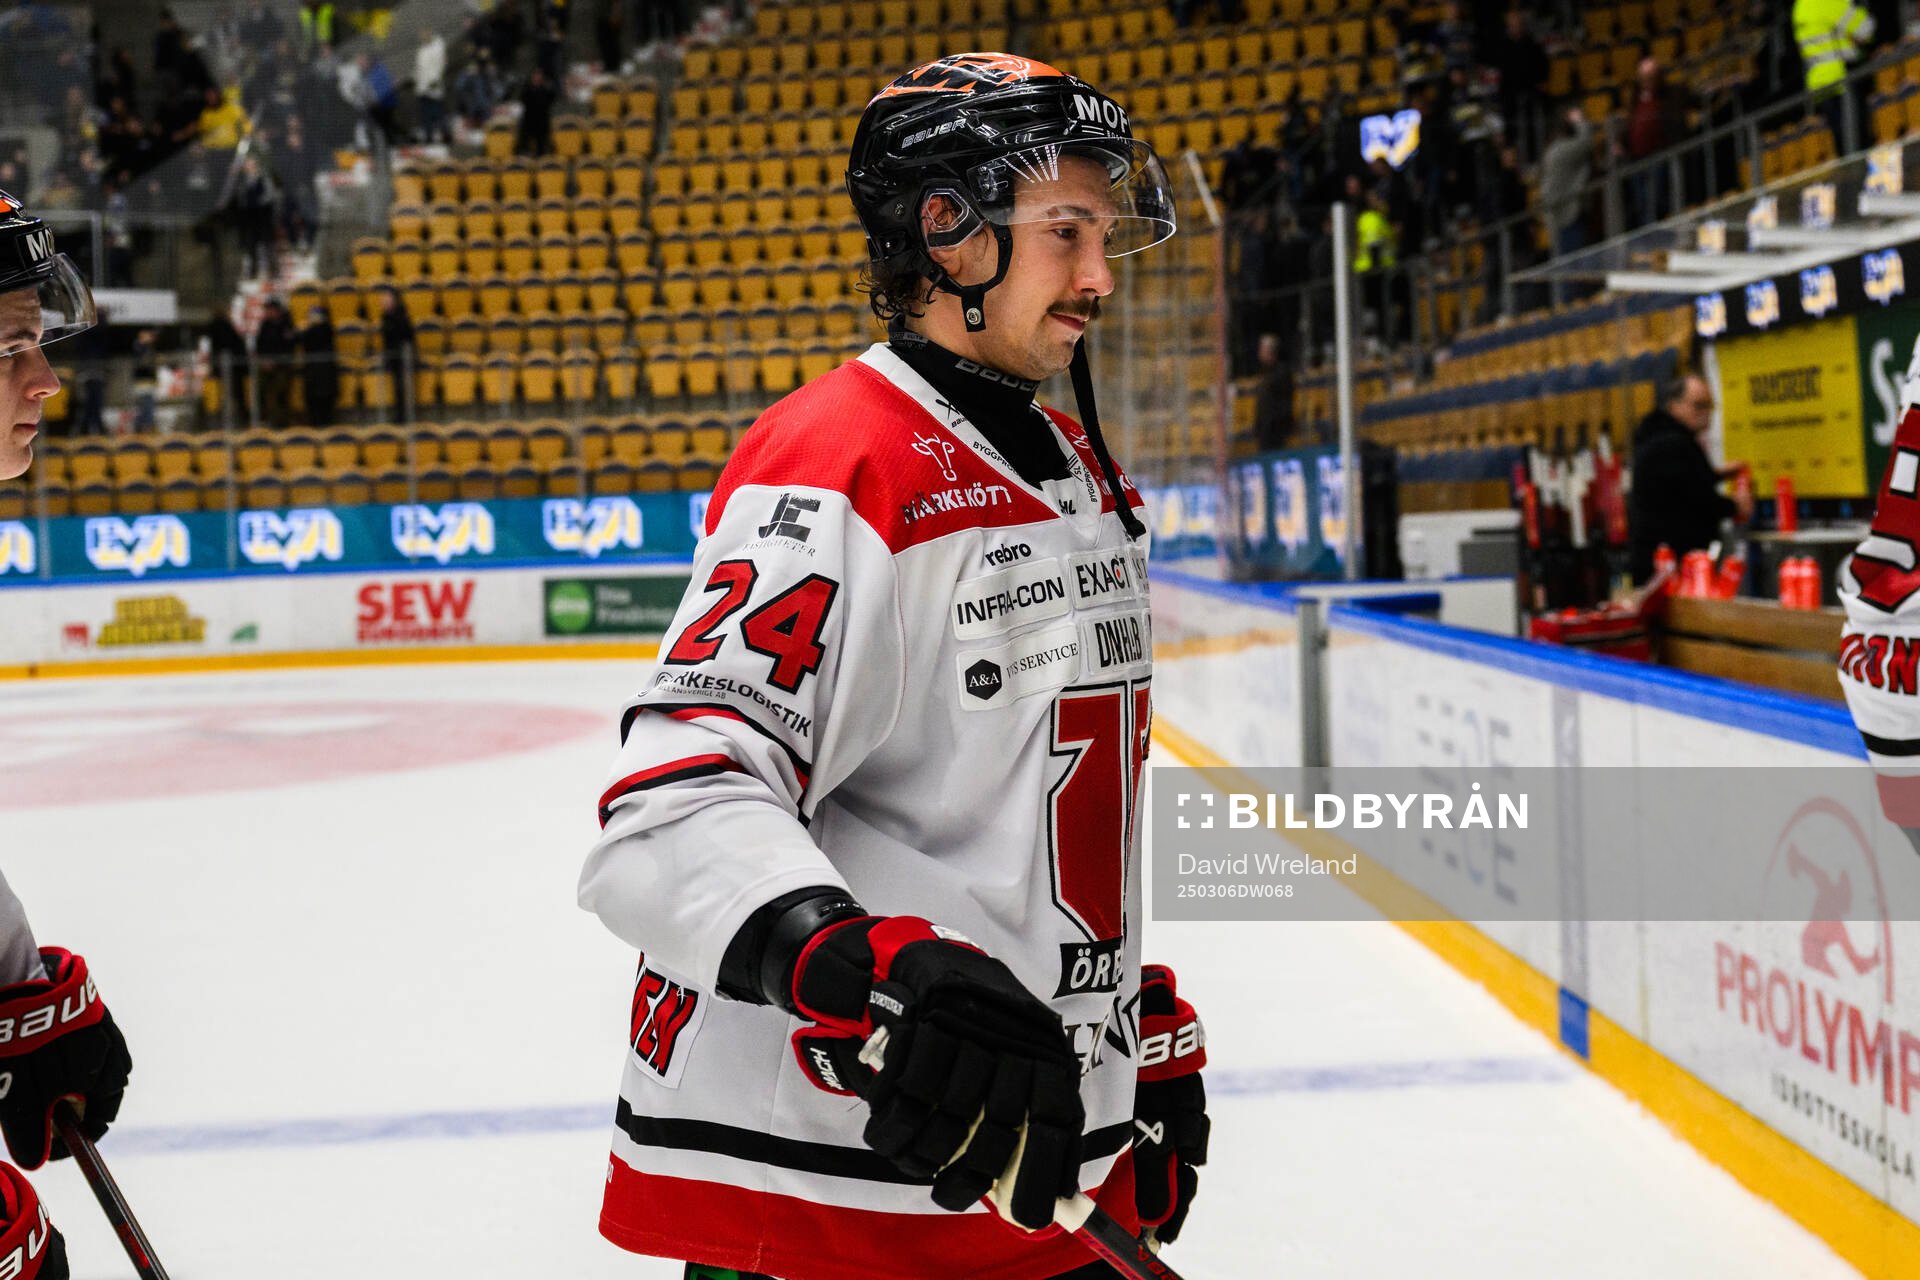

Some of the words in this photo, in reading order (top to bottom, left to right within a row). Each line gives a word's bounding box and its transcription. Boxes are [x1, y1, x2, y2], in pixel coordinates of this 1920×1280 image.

[901, 118, 966, 149] BAUER
[1075, 554, 1131, 599] EXACT
[357, 580, 475, 623] SEW
[956, 576, 1065, 625] INFRA-CON
[664, 558, 840, 696] 24
[969, 672, 1000, 688] A&A
[1020, 642, 1079, 672] SERVICE
